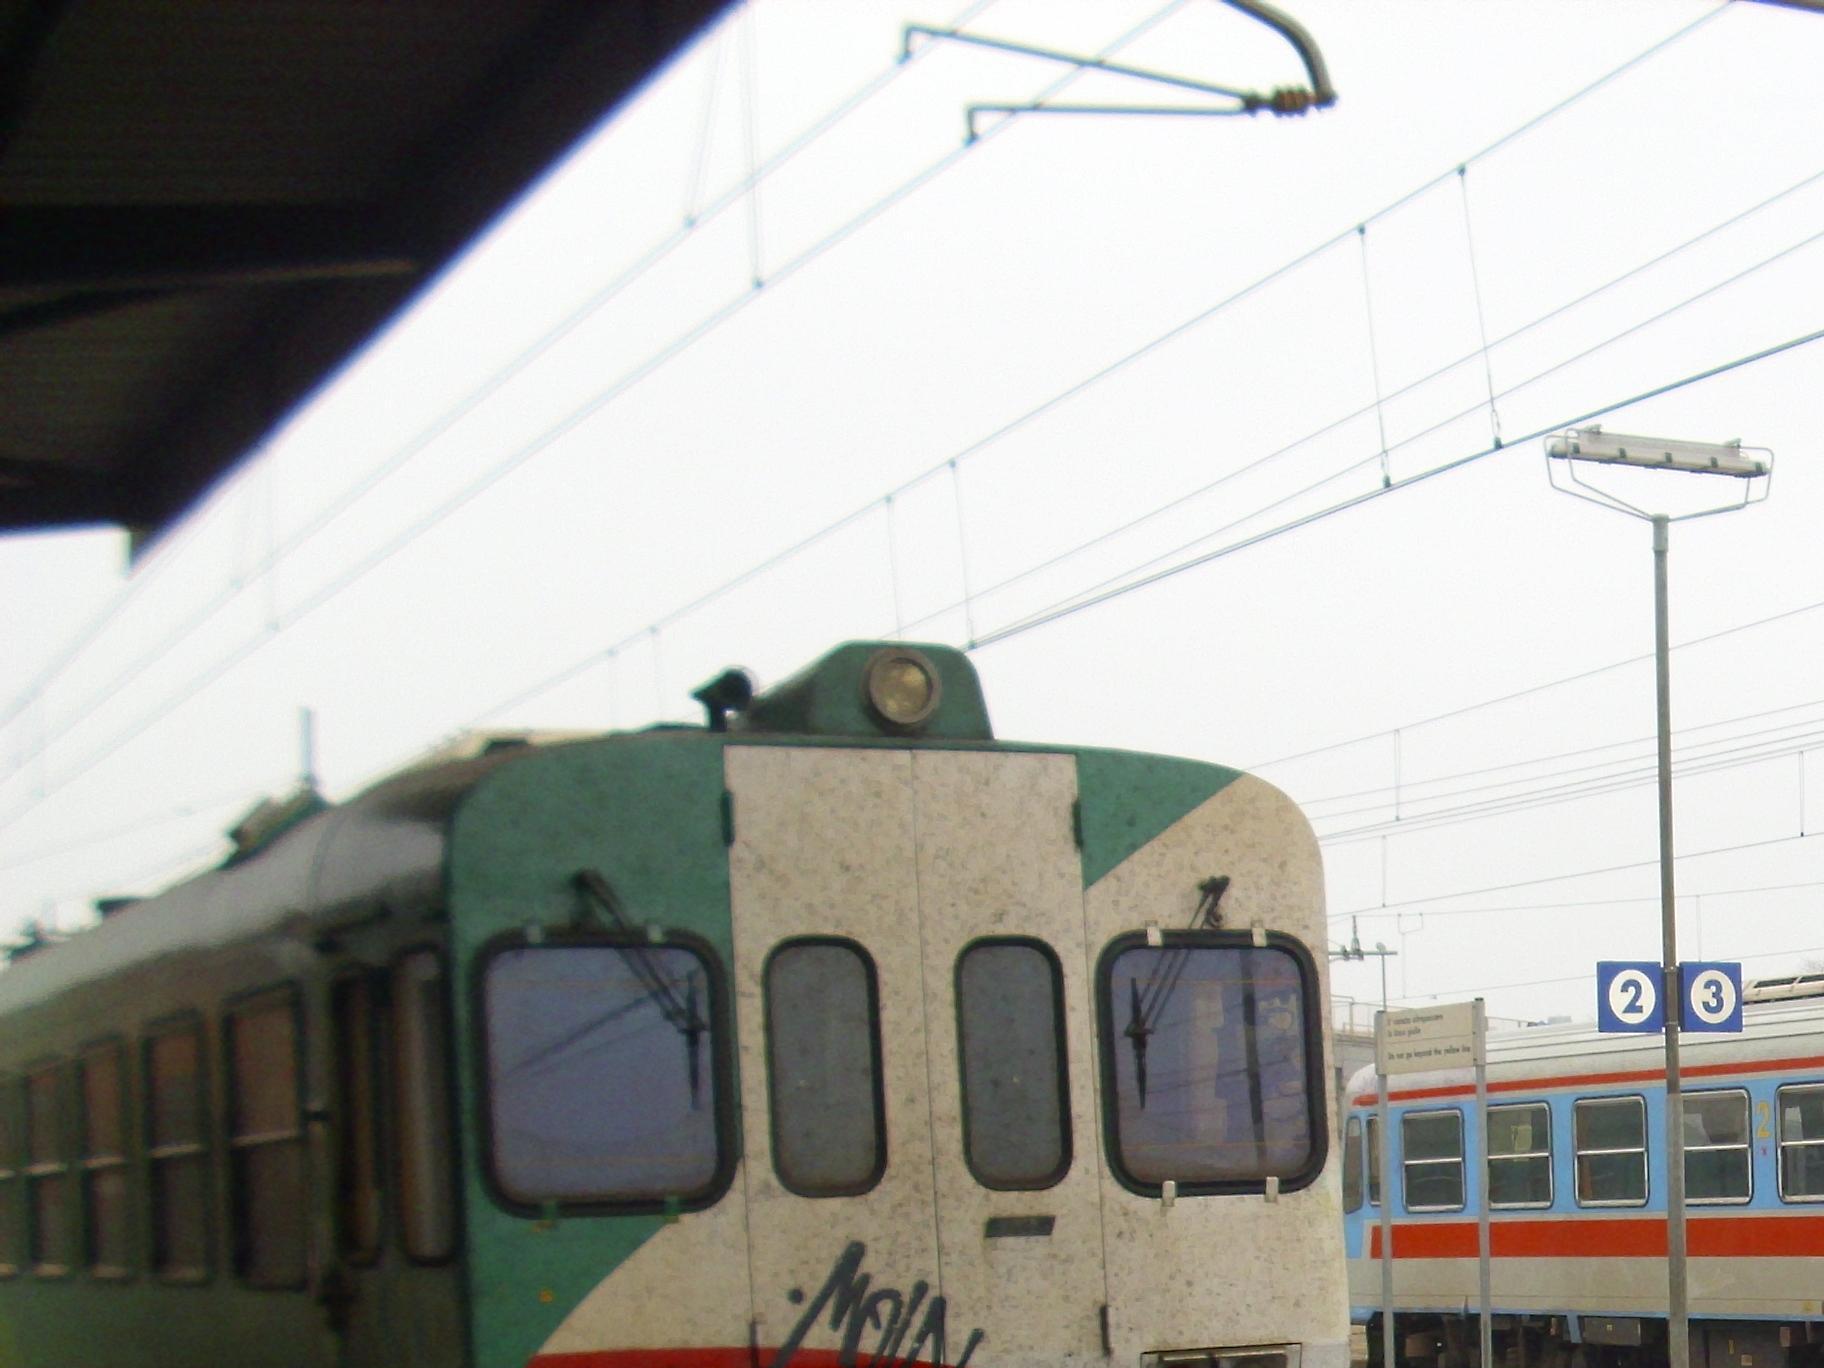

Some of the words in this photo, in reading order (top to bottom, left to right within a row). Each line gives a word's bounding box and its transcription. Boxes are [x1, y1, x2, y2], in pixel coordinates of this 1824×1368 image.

[1619, 978, 1645, 1014] 2
[1702, 978, 1725, 1014] 3
[1755, 1101, 1772, 1139] 2
